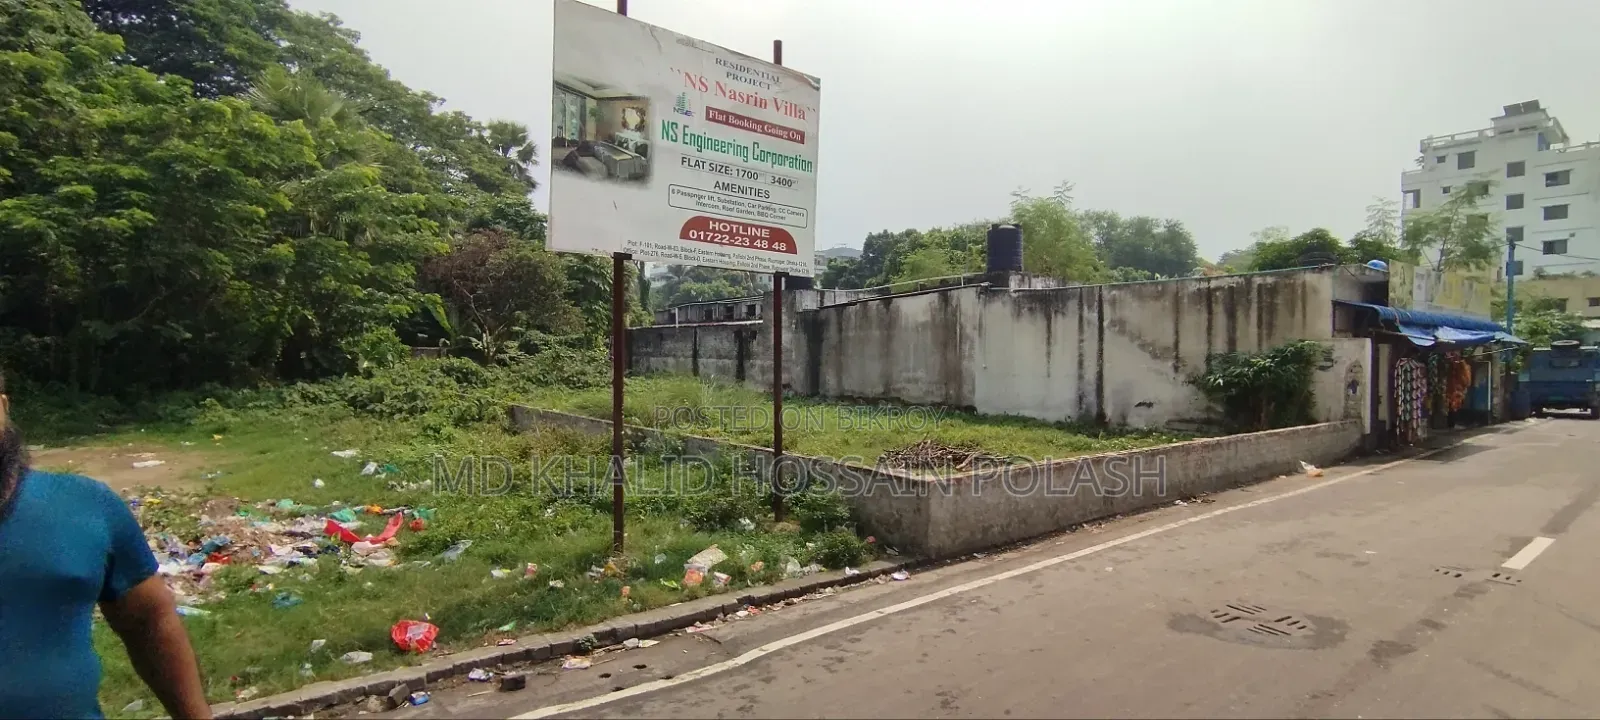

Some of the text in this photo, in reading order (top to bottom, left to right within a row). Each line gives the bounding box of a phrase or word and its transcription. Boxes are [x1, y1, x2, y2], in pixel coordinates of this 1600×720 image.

[715, 57, 782, 84] RESIDENTIAL
[726, 72, 772, 90] PROJECT
[715, 81, 768, 109] Nasrin
[709, 109, 801, 141] Flat Booking Going On
[661, 119, 813, 173] NS Engineering Corporation
[681, 156, 706, 170] FLAT
[708, 162, 733, 176] SIZE:
[713, 181, 770, 199] AMENITIES
[722, 204, 735, 212] Roof
[756, 210, 769, 218] BBQ
[769, 213, 786, 221] Corner
[786, 209, 805, 217] Camera
[709, 220, 771, 238] HOTLINE
[689, 229, 787, 251] 01722-23 48 48
